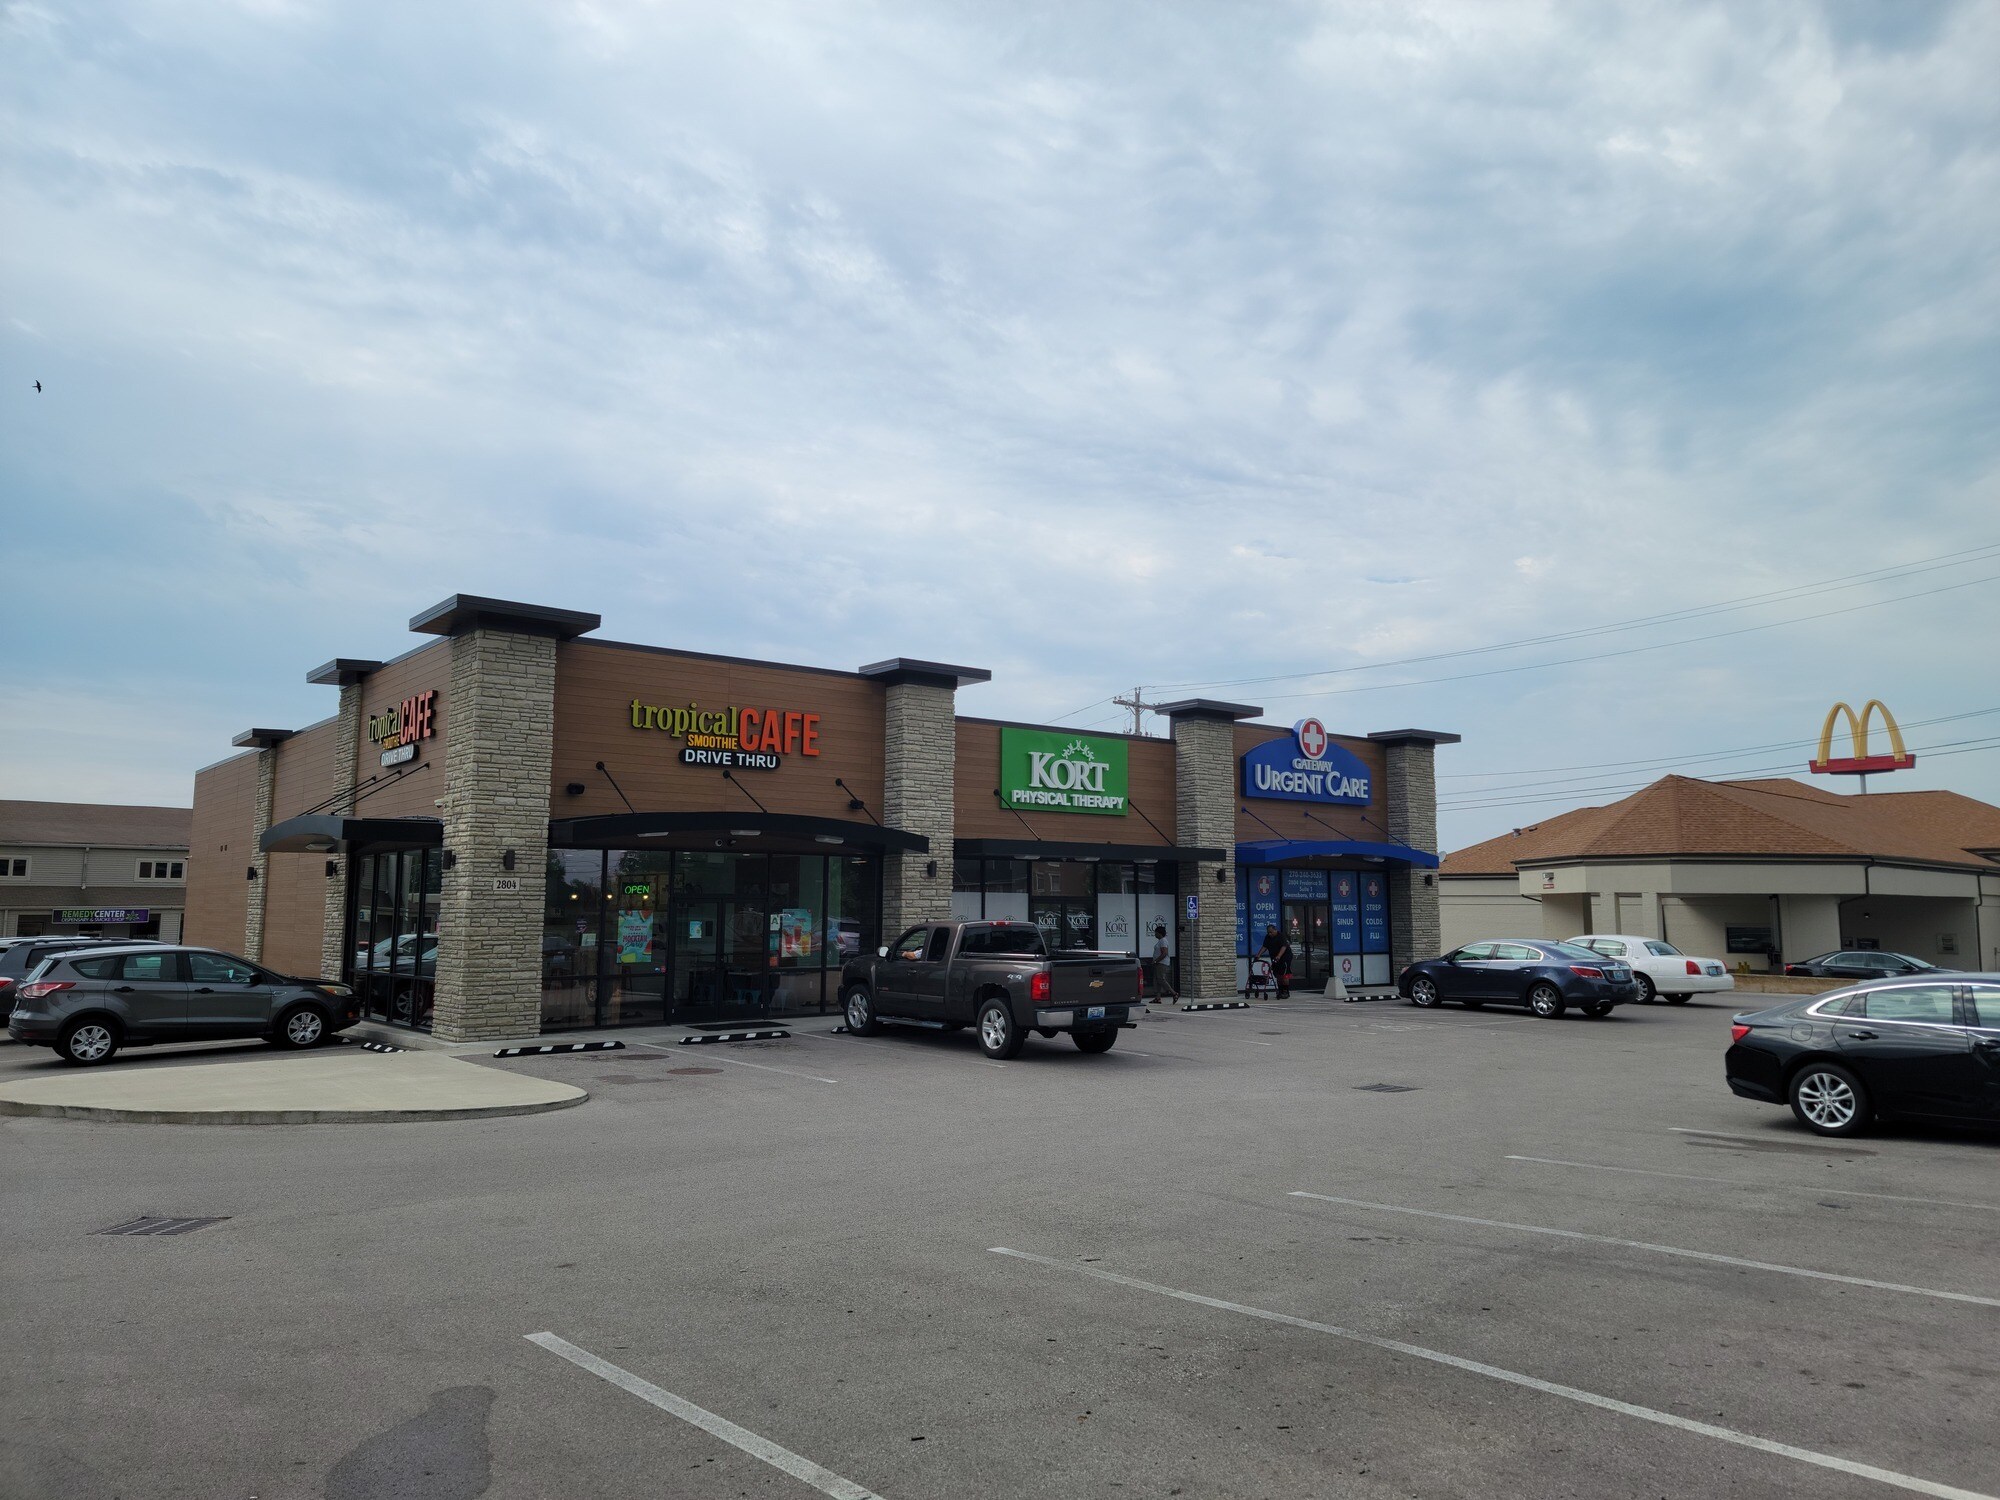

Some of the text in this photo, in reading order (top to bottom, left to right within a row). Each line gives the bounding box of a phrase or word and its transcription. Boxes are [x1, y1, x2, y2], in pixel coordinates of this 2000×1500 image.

[400, 690, 434, 745] CAFE
[631, 699, 821, 756] tropical CAFE
[688, 734, 738, 750] SMOOTHIE
[685, 749, 776, 768] DRIVE THRU
[1292, 758, 1333, 772] GATEWAY
[1028, 751, 1110, 792] KORT
[1255, 763, 1368, 798] URGENT CARE
[1011, 789, 1124, 809] PHYSICAL THERAPY
[496, 880, 517, 889] 2804
[624, 885, 650, 895] OPEN
[1255, 902, 1274, 911] OPEN
[1333, 904, 1357, 912] WALK-INS
[770, 917, 779, 925] A
[1105, 921, 1129, 933] KORT
[1340, 932, 1351, 940] FLU
